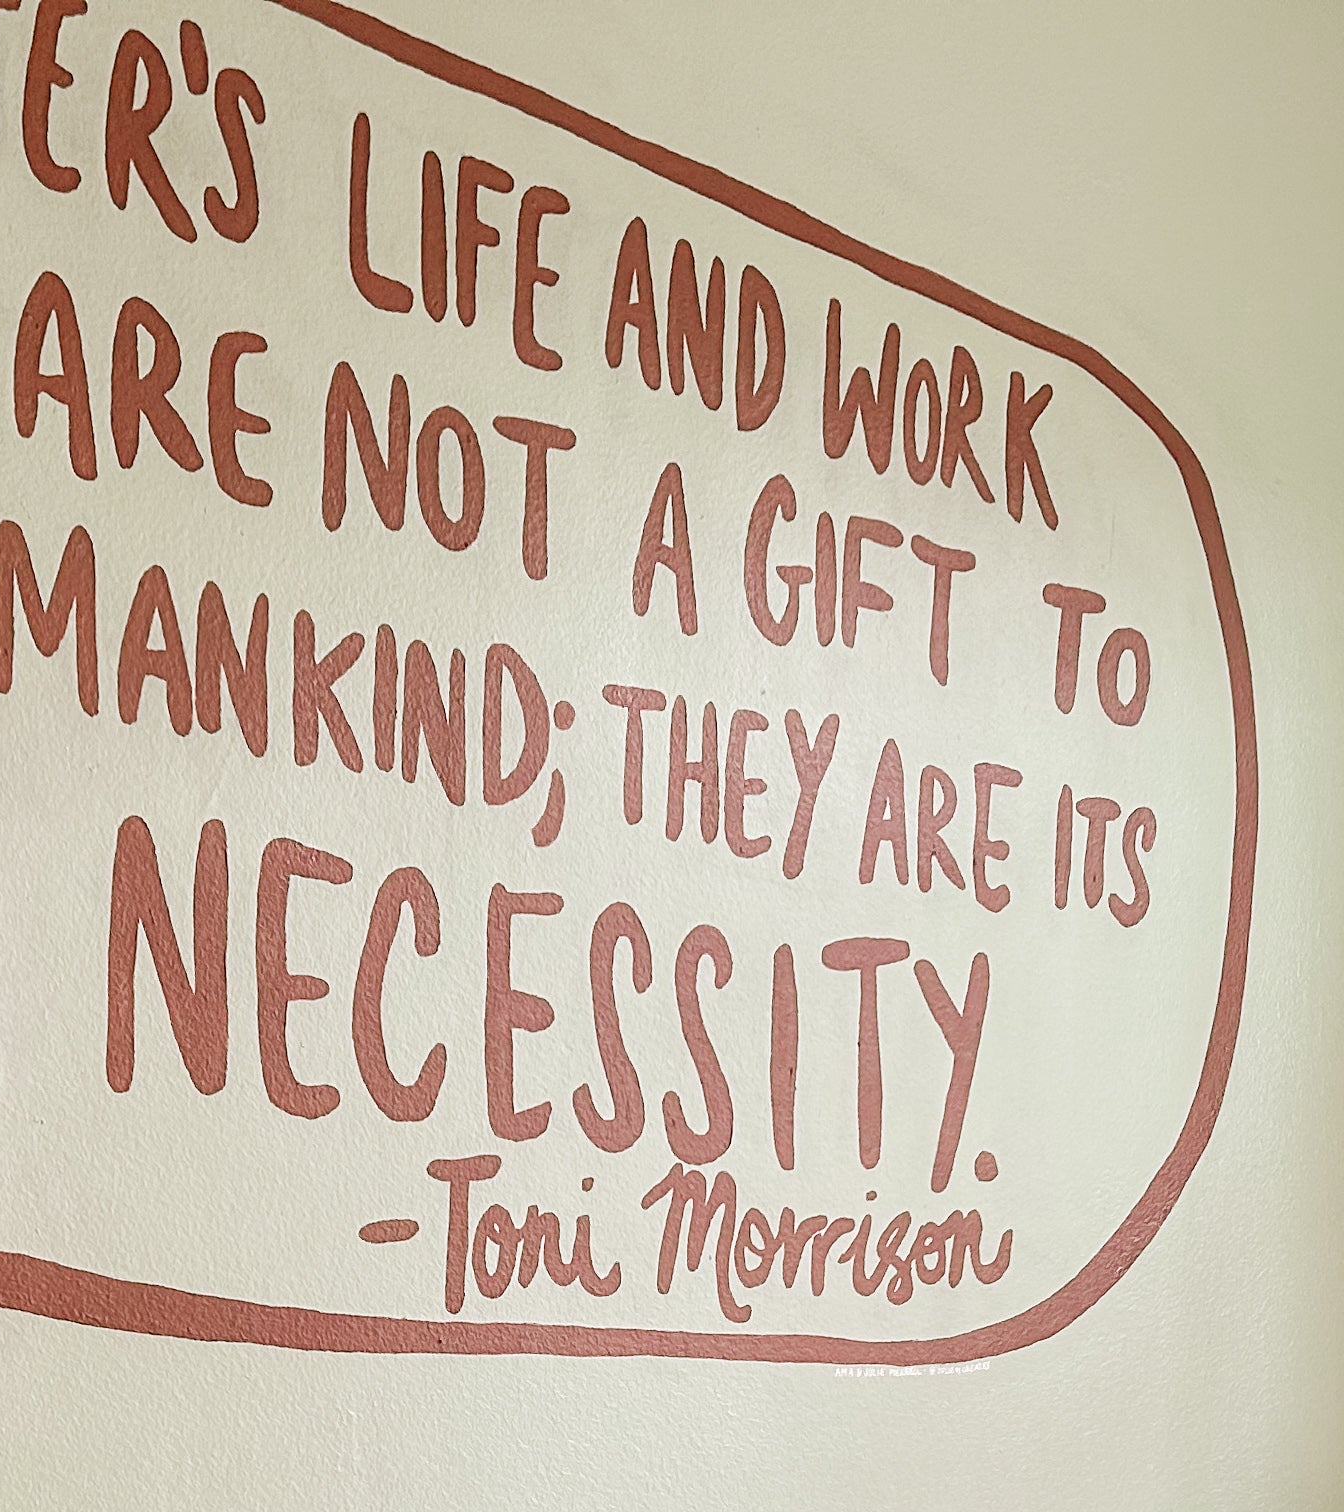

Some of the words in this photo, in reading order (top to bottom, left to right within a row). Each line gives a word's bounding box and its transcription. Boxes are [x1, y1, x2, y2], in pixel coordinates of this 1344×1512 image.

[14, 271, 273, 507] ARE
[321, 361, 577, 580] NOT
[632, 462, 699, 636] A
[744, 474, 976, 686] GIFT
[1042, 582, 1151, 727] TO
[349, 112, 570, 372] LIFE
[605, 216, 786, 432] AND
[823, 297, 1059, 531] WORK
[602, 684, 840, 880] THEY
[858, 738, 1024, 913] ARE
[1054, 784, 1157, 928] ITS
[106, 815, 999, 1193] NECESSITY.
[642, 1163, 1014, 1323] Morrison
